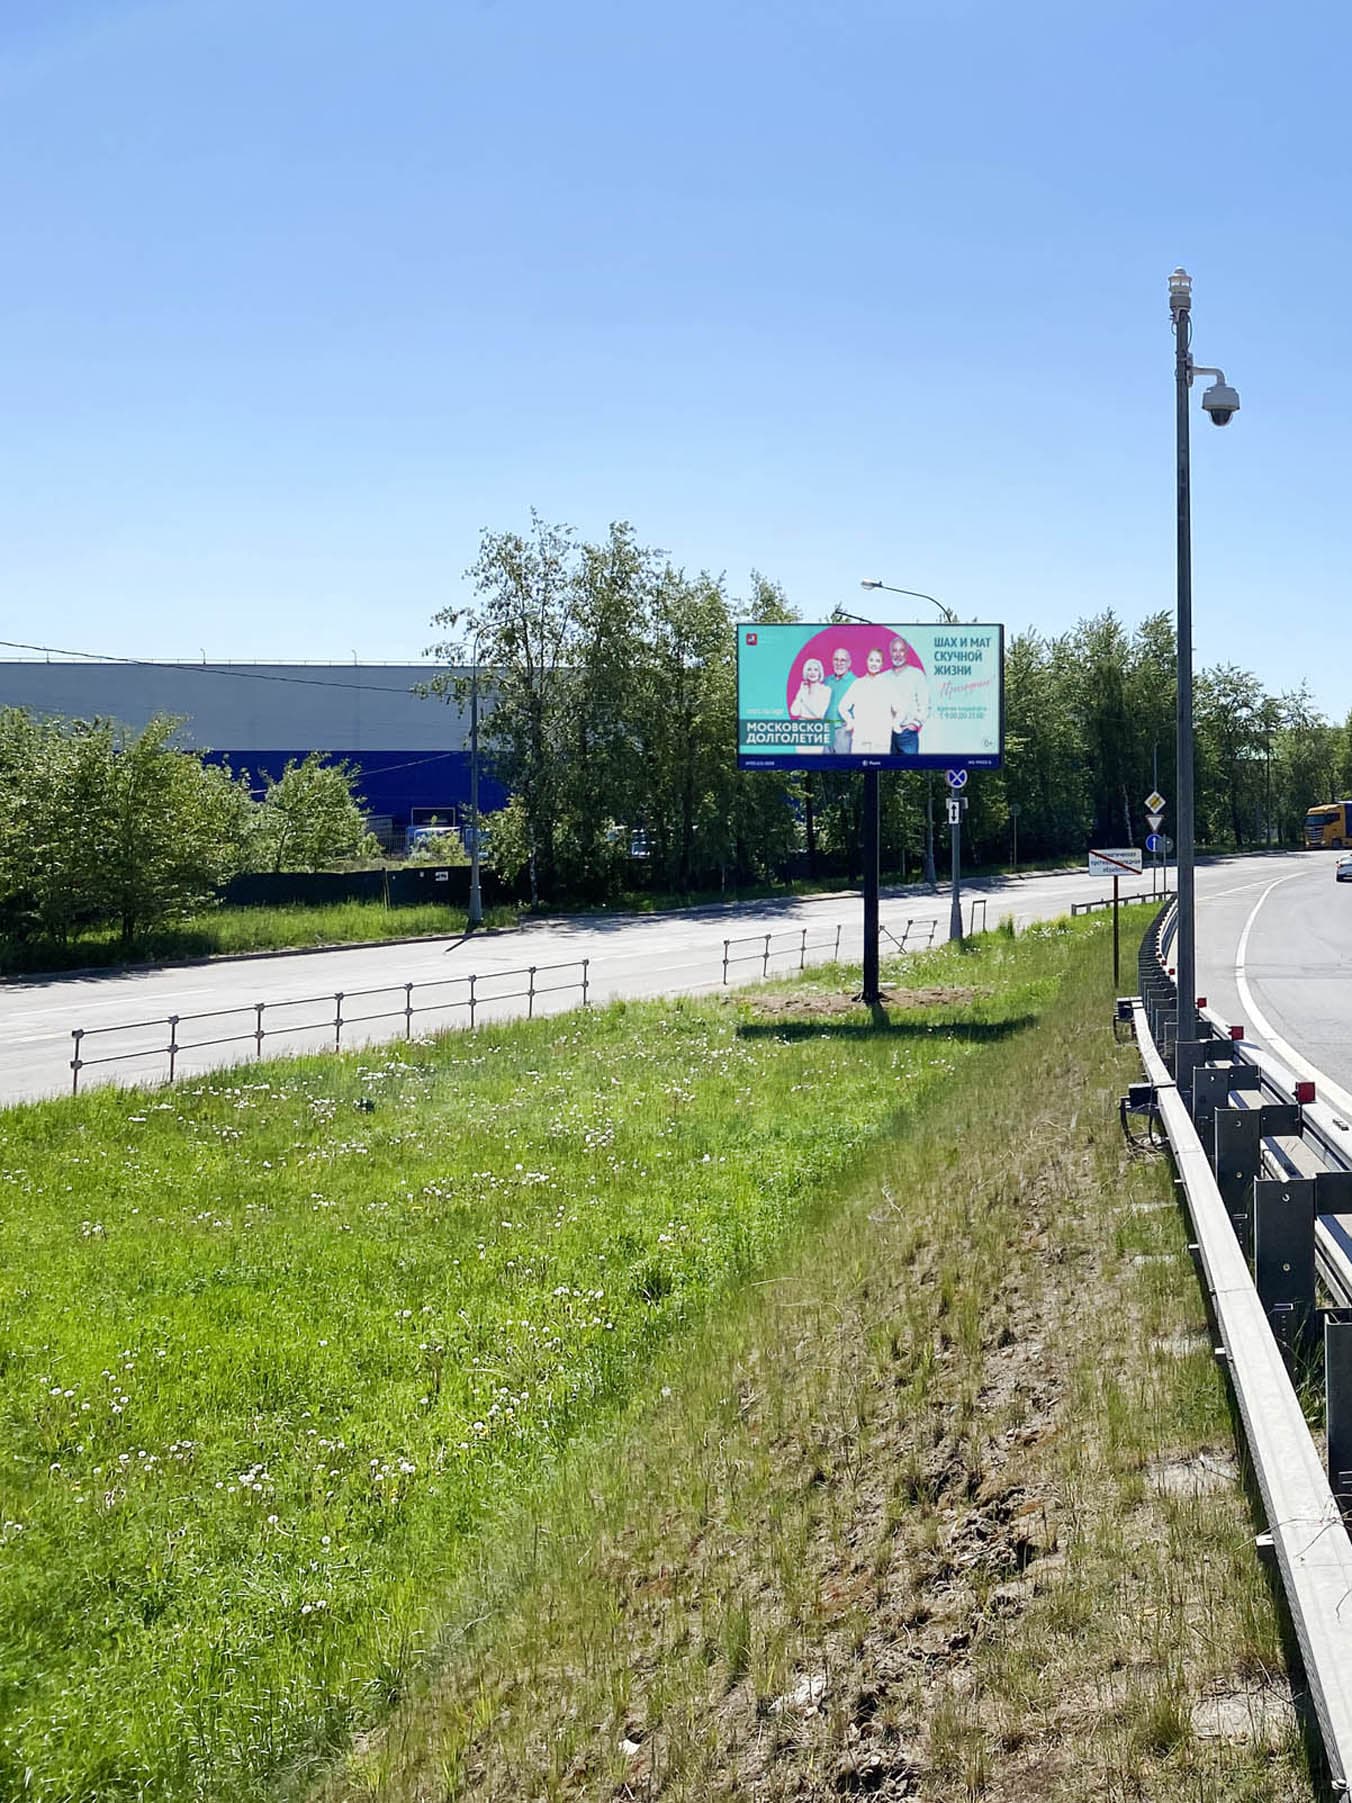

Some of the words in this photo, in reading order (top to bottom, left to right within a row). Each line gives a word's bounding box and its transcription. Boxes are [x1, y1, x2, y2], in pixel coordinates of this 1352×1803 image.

[934, 637, 958, 648] ШАХ
[960, 637, 968, 648] И
[970, 637, 992, 648] МАТ
[934, 649, 983, 662] СКУЧНОЙ
[934, 665, 972, 676] ЖИЗНИ
[746, 722, 831, 732] МОСКОВСКОЕ
[746, 733, 831, 744] ДОЛГОЛЕТИЕ
